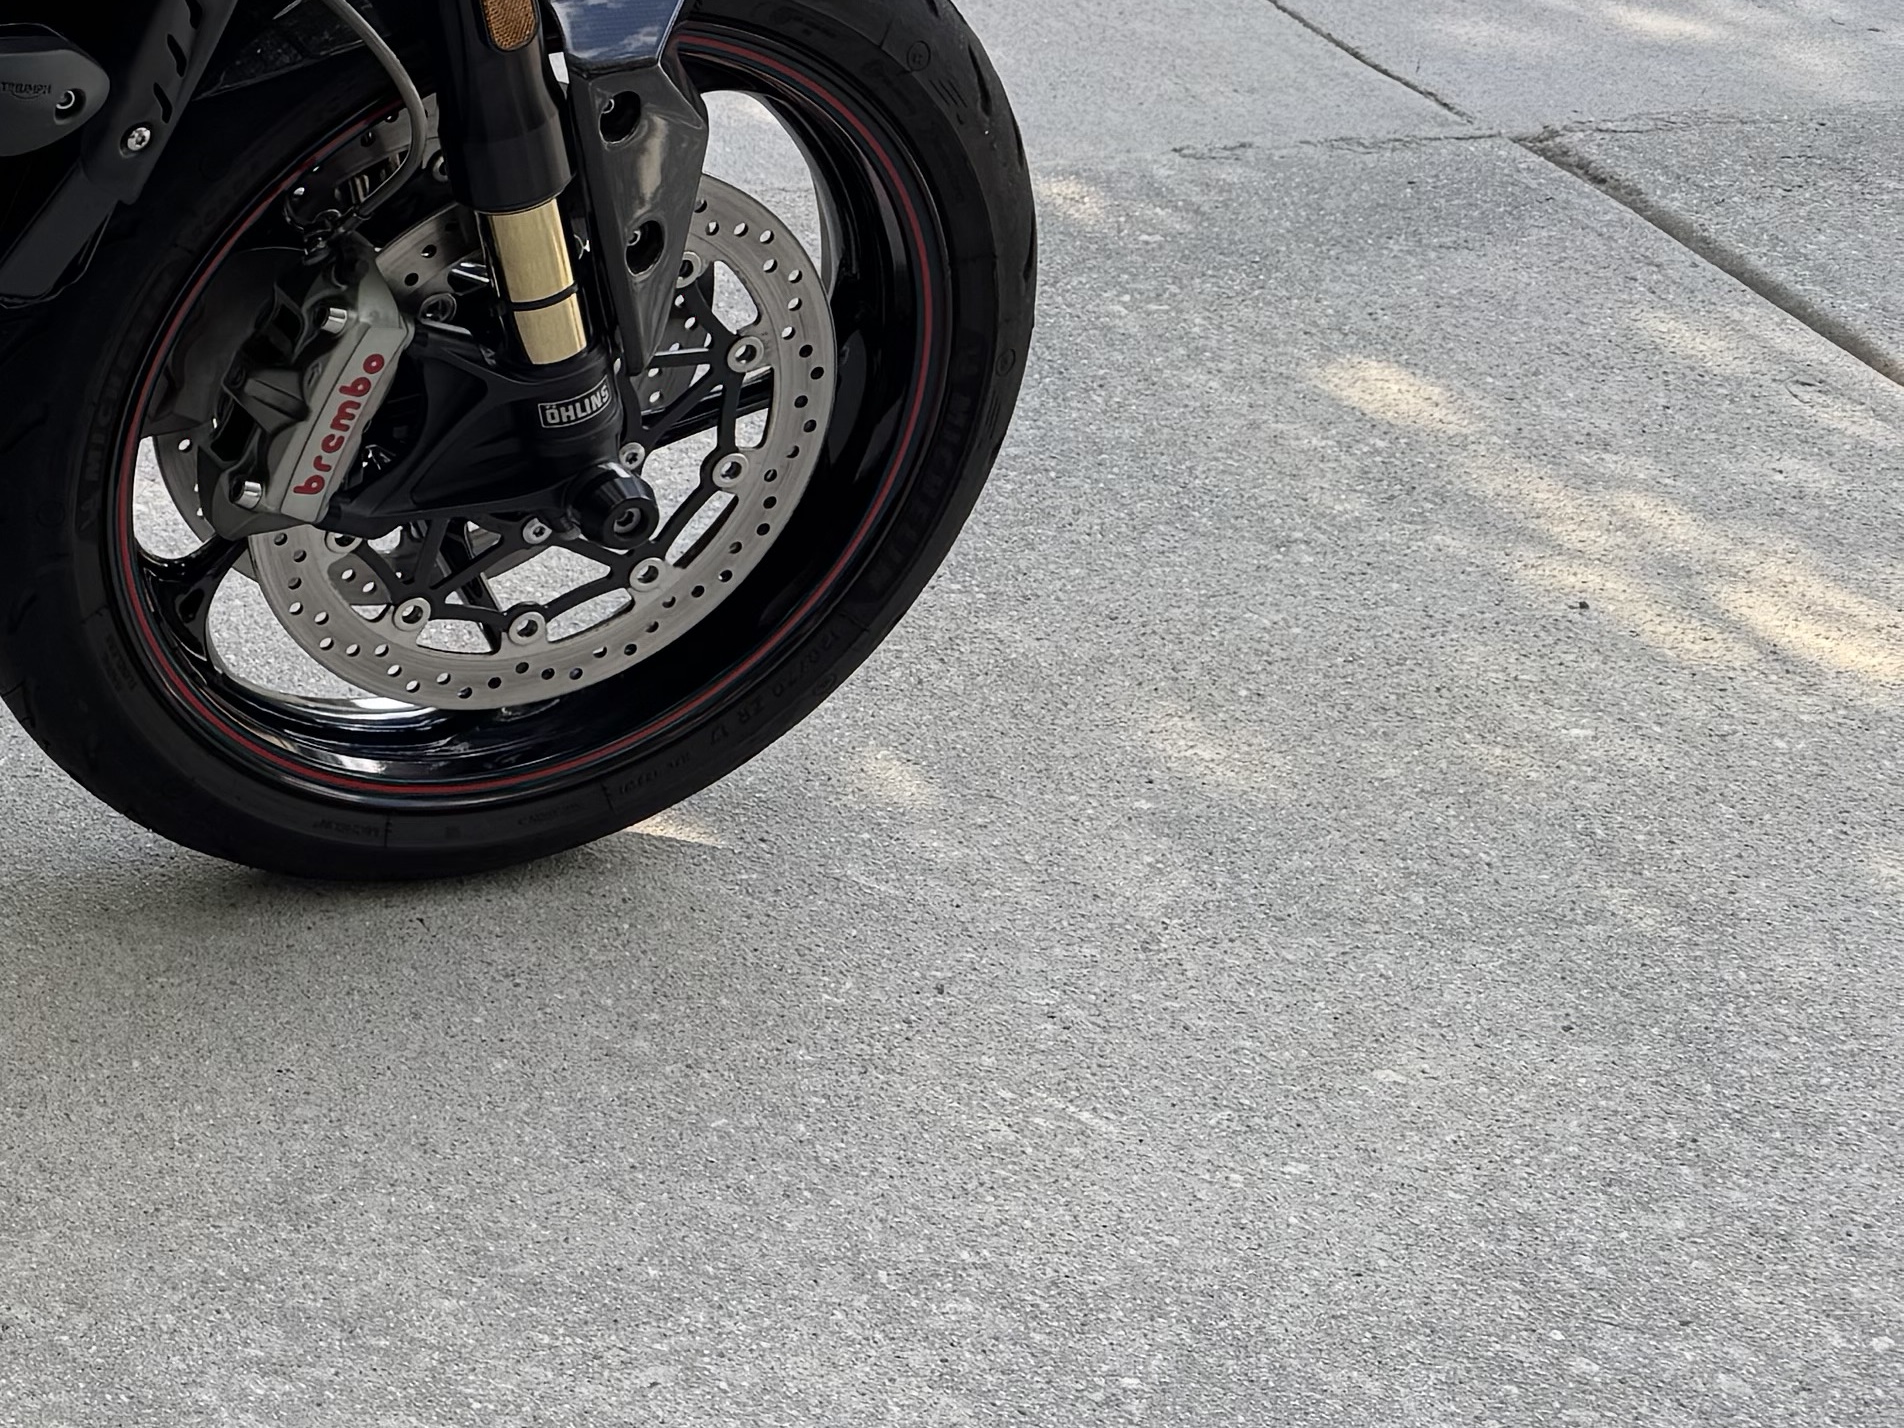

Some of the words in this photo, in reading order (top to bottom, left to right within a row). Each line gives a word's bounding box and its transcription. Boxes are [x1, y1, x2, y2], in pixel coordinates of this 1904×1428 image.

[0, 81, 52, 100] TRIUMPH
[545, 384, 609, 424] ÖHLINS
[293, 353, 385, 496] brembo
